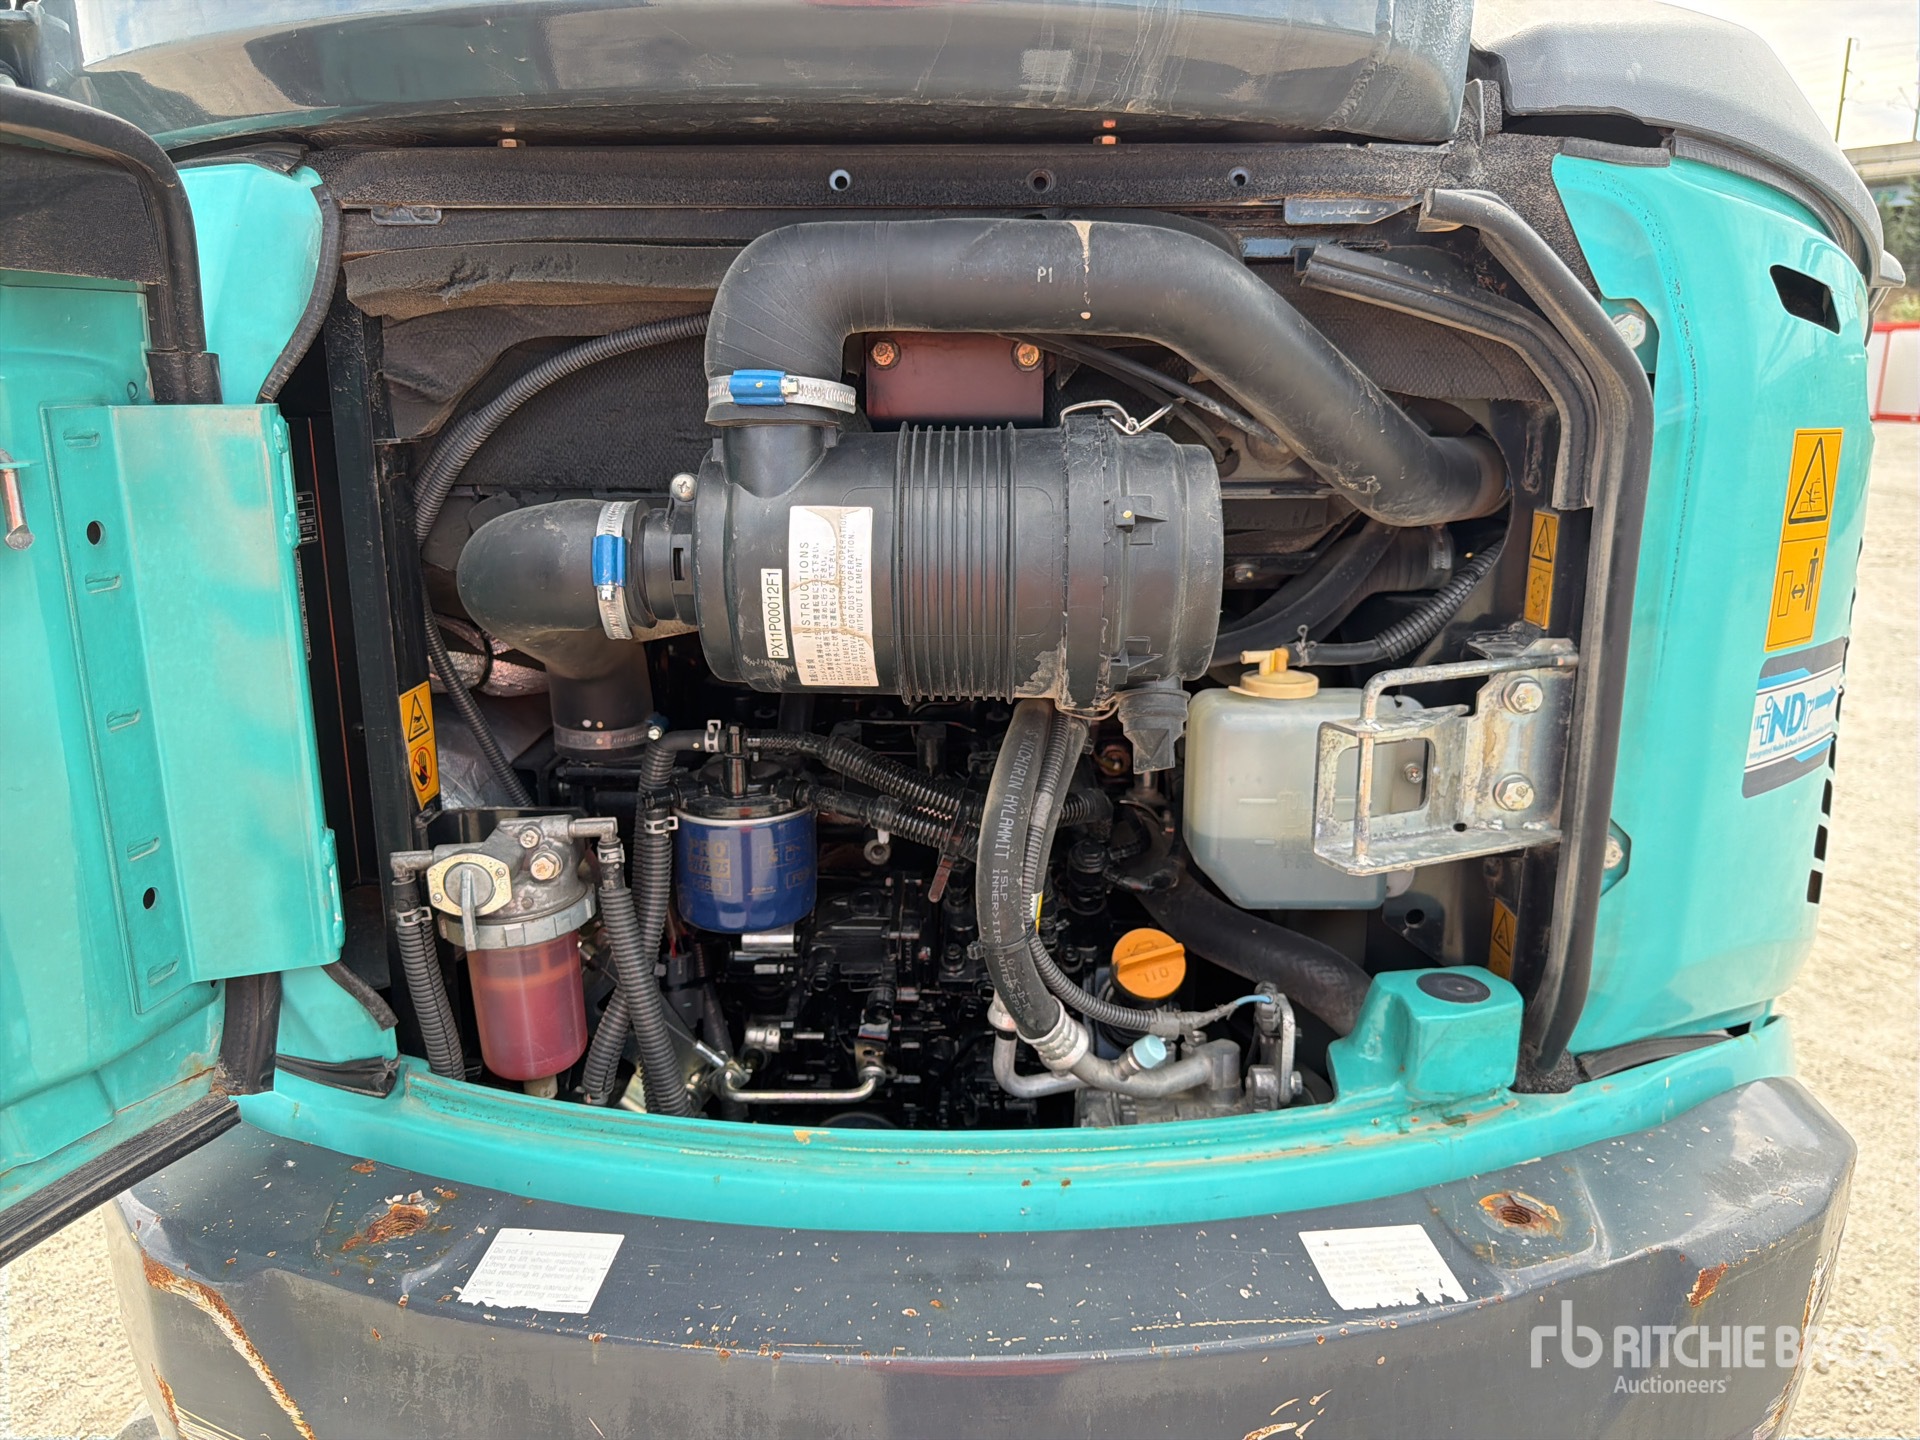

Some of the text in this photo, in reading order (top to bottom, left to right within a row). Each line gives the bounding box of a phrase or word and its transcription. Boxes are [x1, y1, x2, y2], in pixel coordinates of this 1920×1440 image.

[766, 572, 784, 657] PX11P00012F1
[799, 541, 812, 638] INSTRUCTIONS
[856, 597, 864, 631] WITHOUT
[842, 639, 851, 665] ELEMENT
[994, 794, 1019, 859] HYLAMMIT
